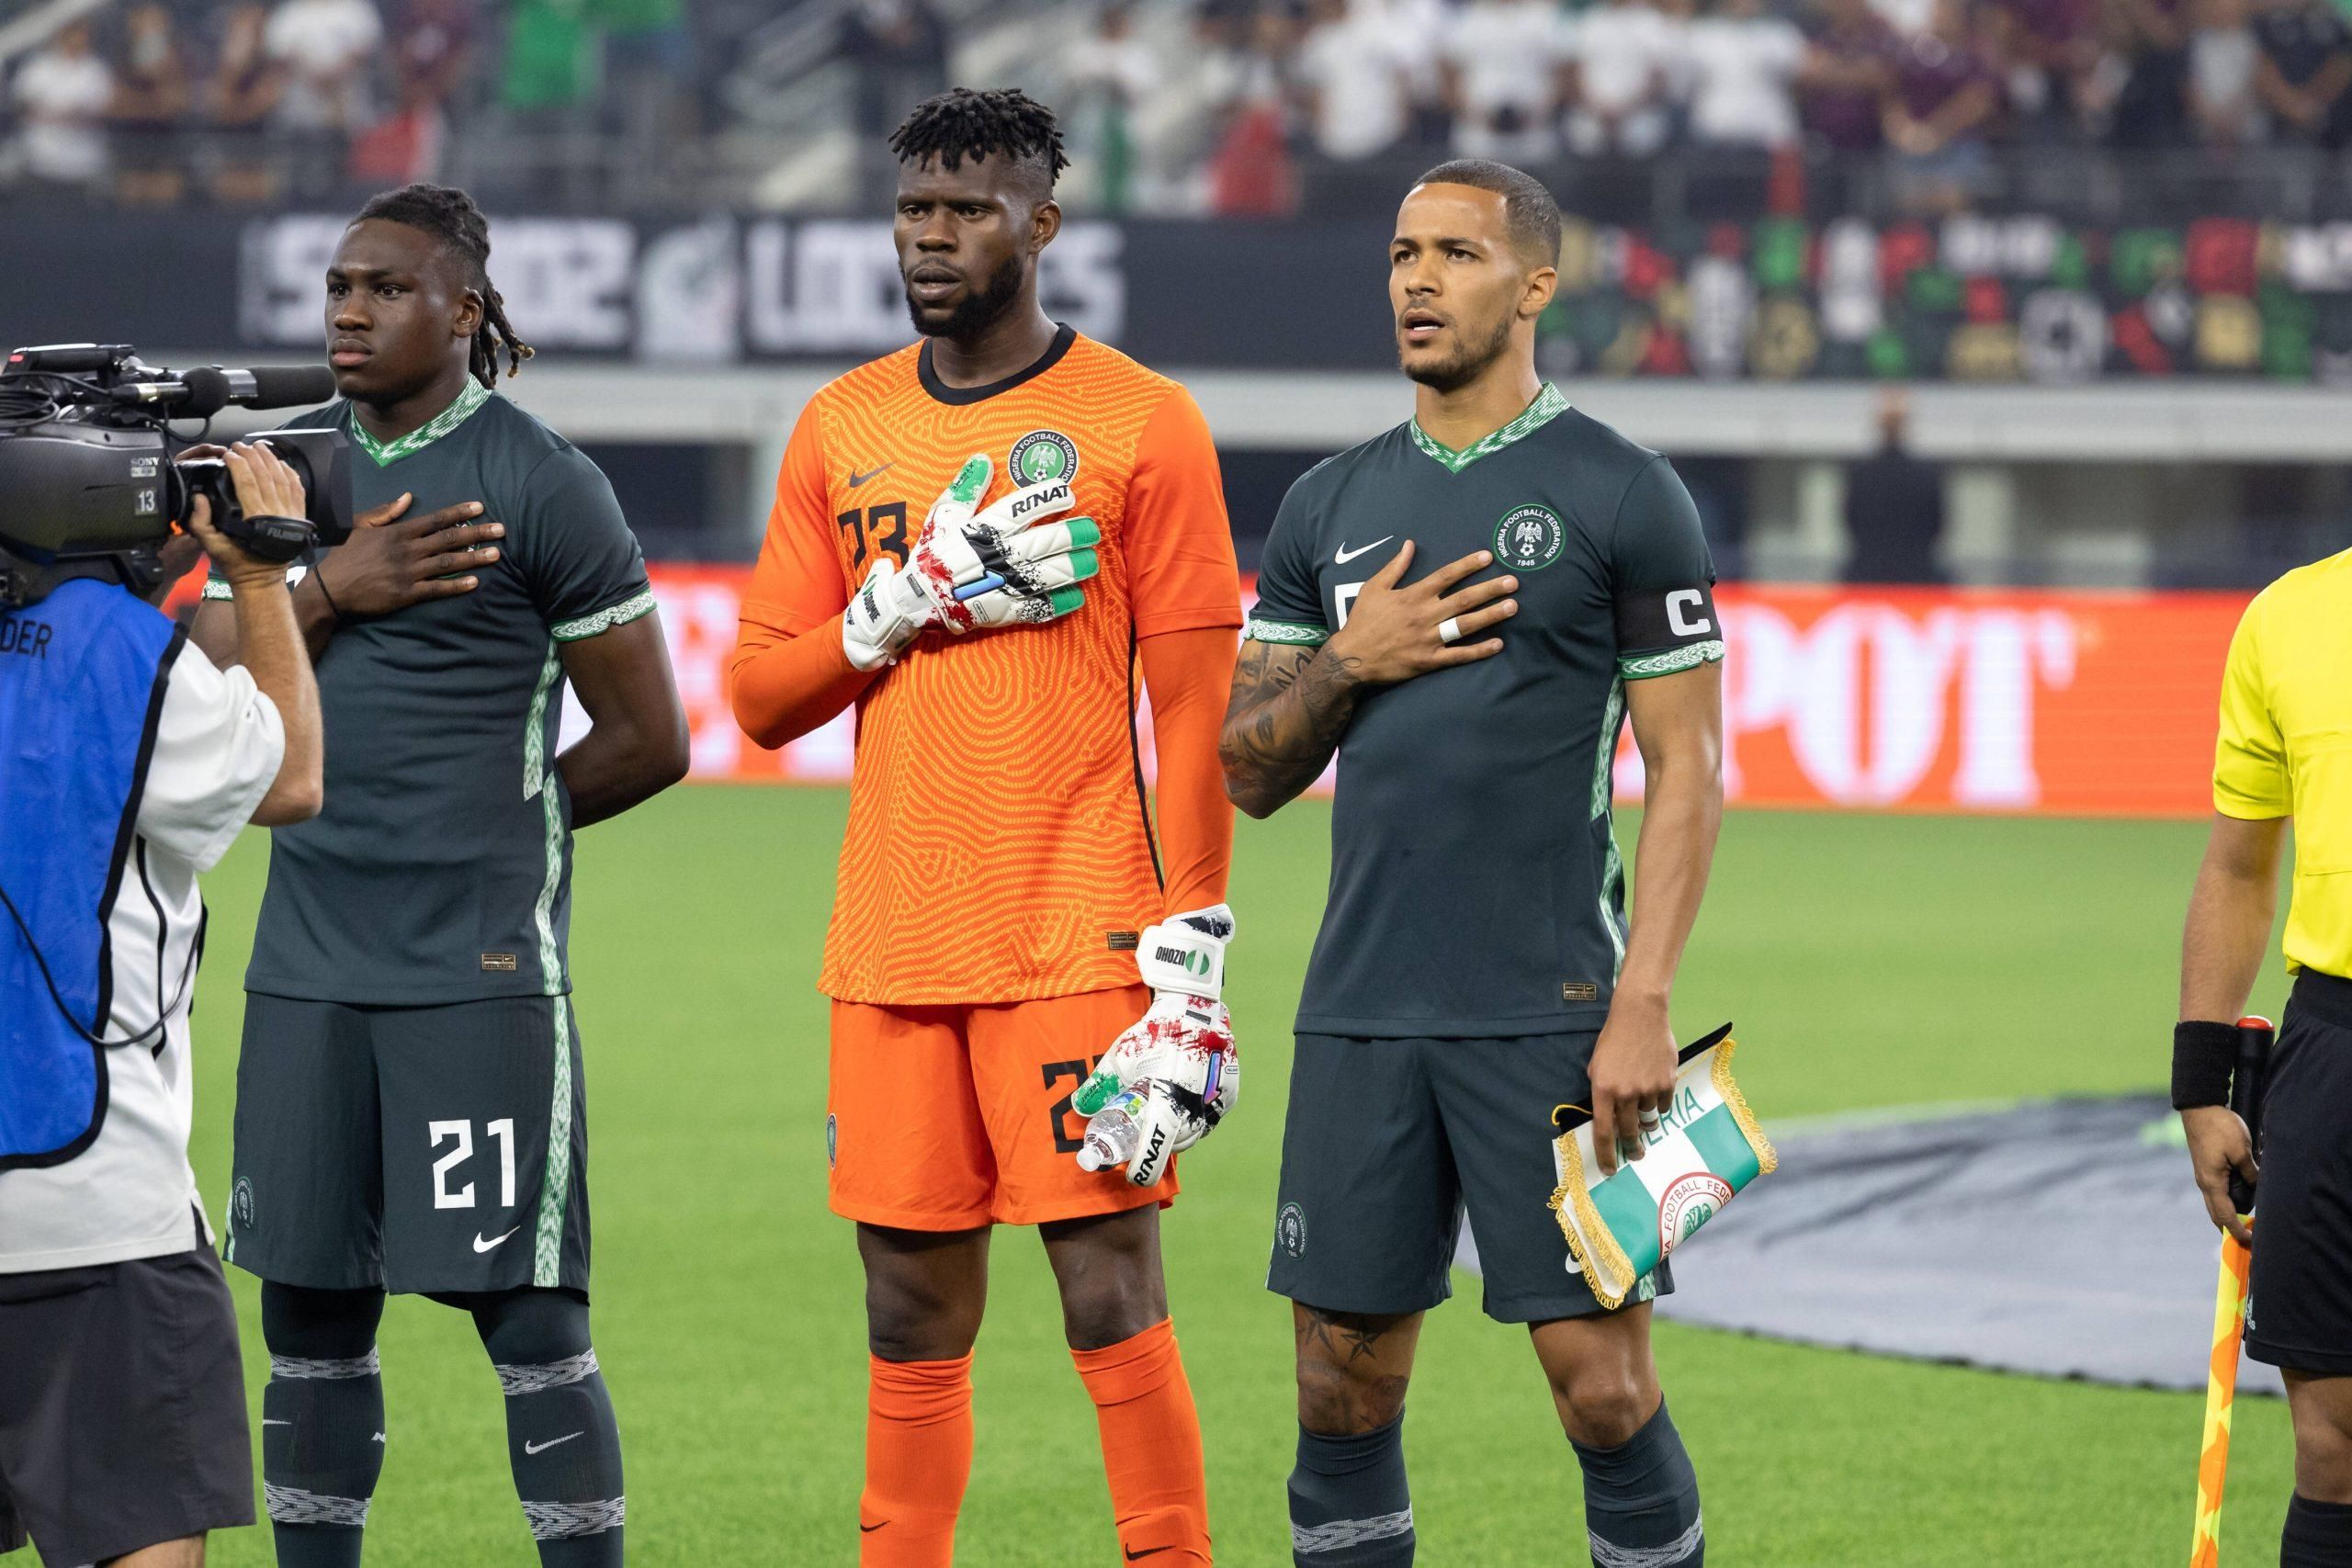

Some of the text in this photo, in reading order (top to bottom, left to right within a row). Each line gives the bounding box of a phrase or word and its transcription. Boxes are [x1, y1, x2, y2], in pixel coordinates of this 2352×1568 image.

[1012, 434, 1075, 481] NIGERIA FOOTBALL FEDERATIO
[139, 490, 155, 512] 13
[1012, 484, 1069, 518] RINAT
[1497, 509, 1561, 559] NIGERIA FOOTBALL FEDERATION
[1517, 558, 1535, 567] 1945
[1666, 589, 1711, 637] C
[428, 1118, 515, 1209] 21
[1133, 1122, 1166, 1187] RINAT
[1664, 1180, 1702, 1232] FOOTBALL
